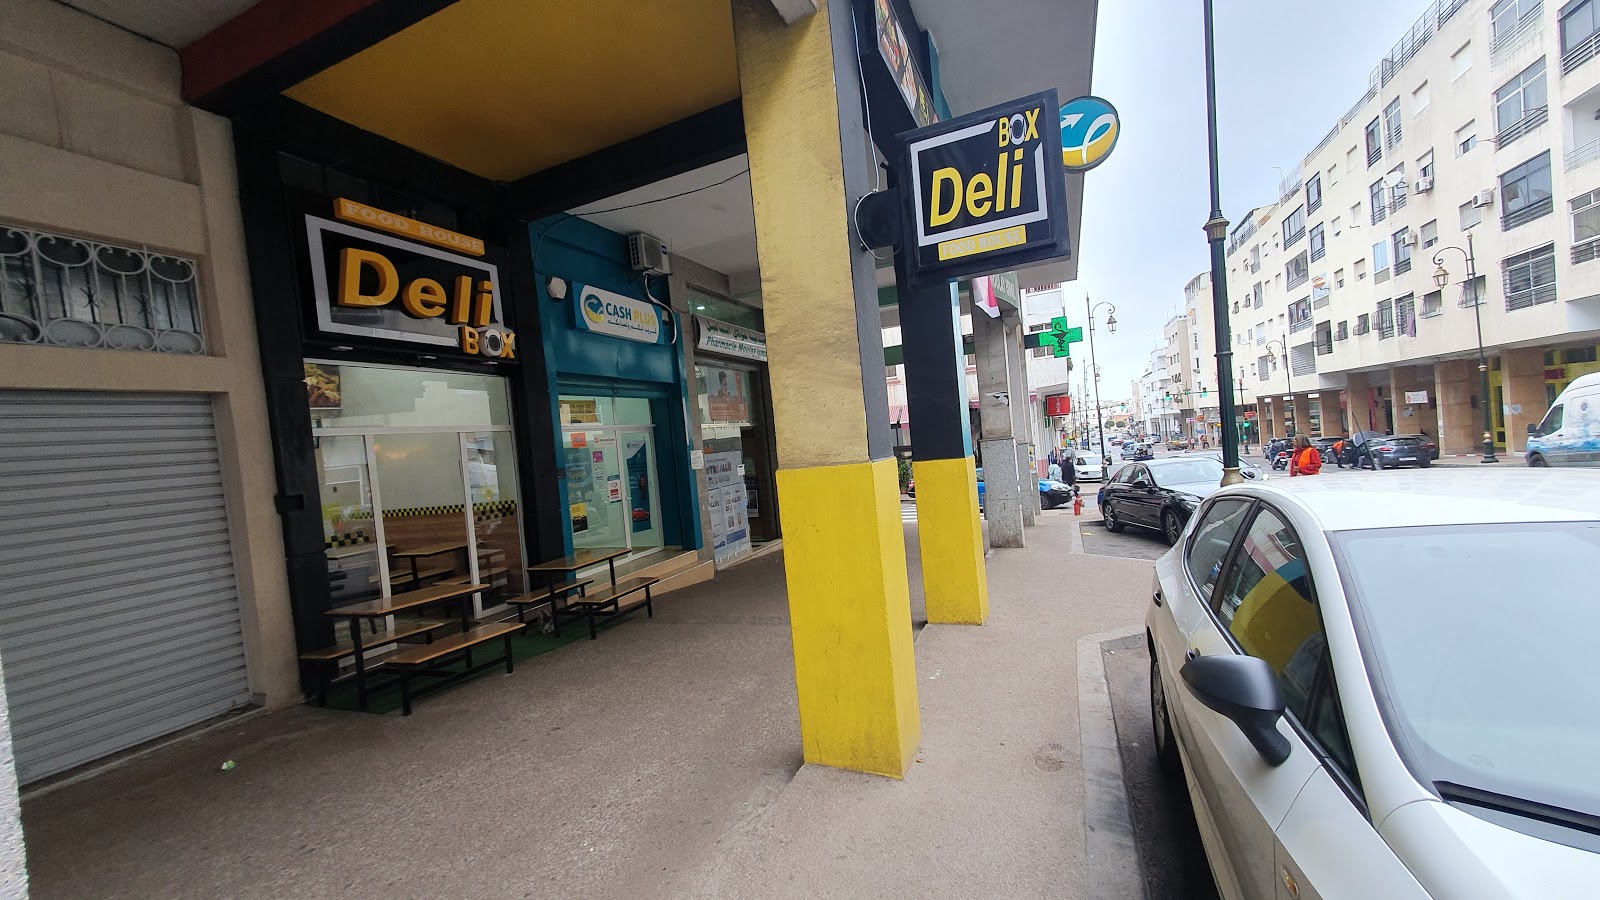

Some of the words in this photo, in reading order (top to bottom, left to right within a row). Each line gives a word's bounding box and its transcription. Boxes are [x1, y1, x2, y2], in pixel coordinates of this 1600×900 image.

[998, 108, 1040, 148] BOX
[930, 148, 1024, 228] Deli
[345, 203, 410, 230] FOOD
[419, 224, 482, 250] HOUSE
[943, 239, 976, 257] FOOD
[978, 229, 1021, 248] HOUSE
[337, 247, 493, 326] Deli
[605, 302, 632, 321] CASH
[633, 309, 657, 327] PLUS
[461, 325, 515, 358] BOX
[706, 335, 737, 352] Pharmacie
